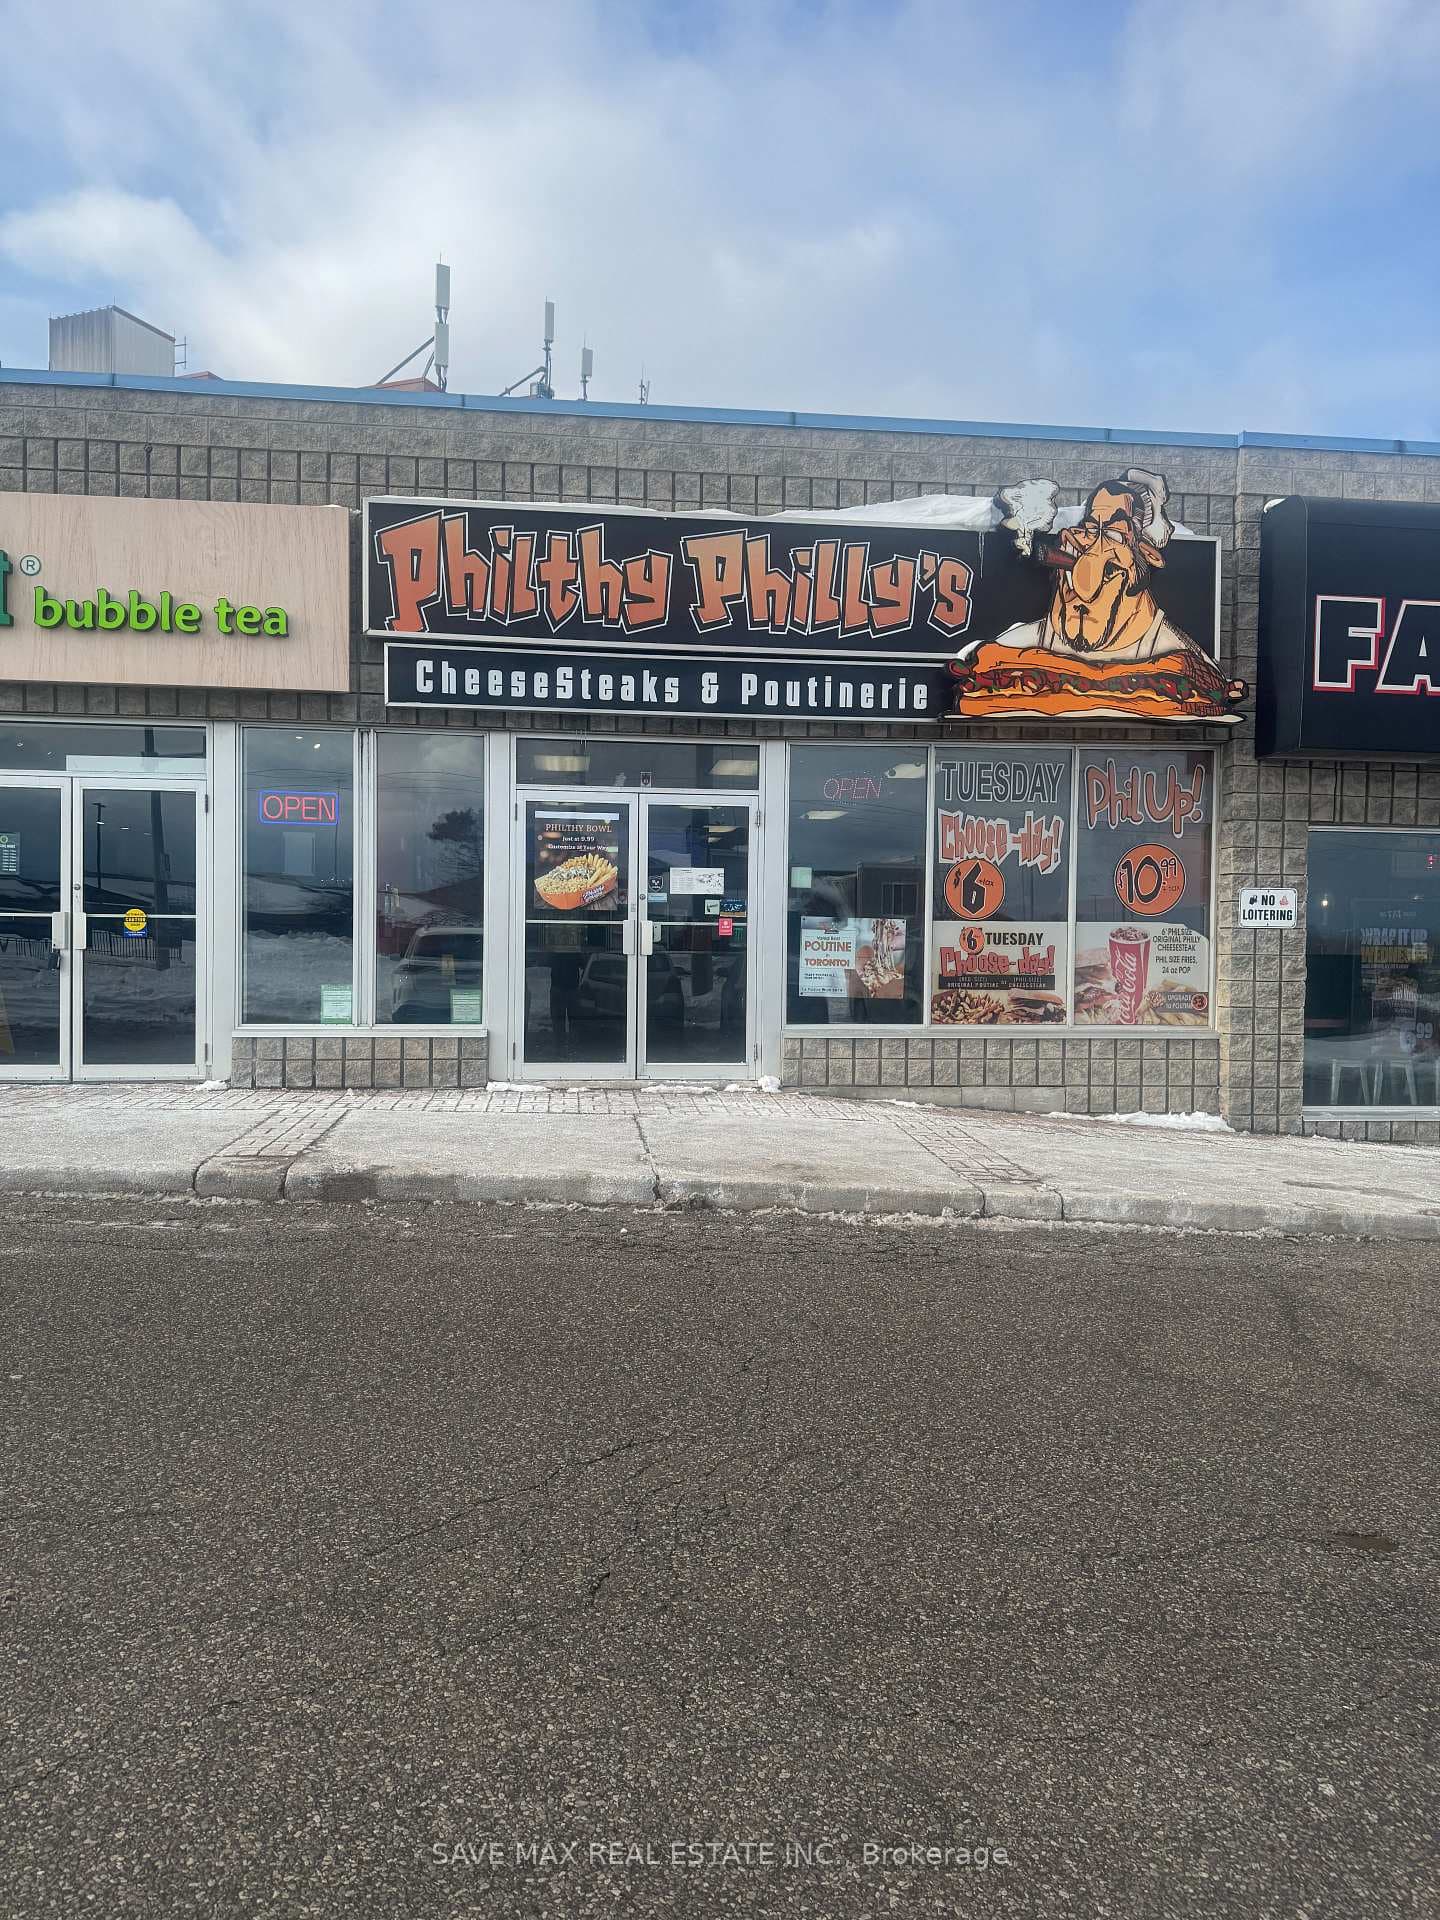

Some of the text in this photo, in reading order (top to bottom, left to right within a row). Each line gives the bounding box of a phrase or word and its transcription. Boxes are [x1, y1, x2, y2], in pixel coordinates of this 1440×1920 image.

[374, 509, 974, 638] Philthy Philly's
[34, 586, 202, 633] bubble
[214, 597, 288, 636] tea
[416, 660, 928, 710] CheeseSteaks & Poutinerie
[824, 777, 882, 800] OPEN
[940, 761, 1064, 802] TUESDAY
[1085, 758, 1205, 838] Phil Up!
[263, 795, 335, 820] OPEN
[545, 824, 612, 833] PHILTHY BOWL
[1261, 894, 1276, 906] NO
[1242, 909, 1293, 921] LOITERING
[804, 940, 852, 952] POUTINE
[985, 932, 1044, 946] TUESDAY
[1152, 935, 1201, 943] ORIGINAL PHILLY
[1178, 966, 1191, 974] POP
